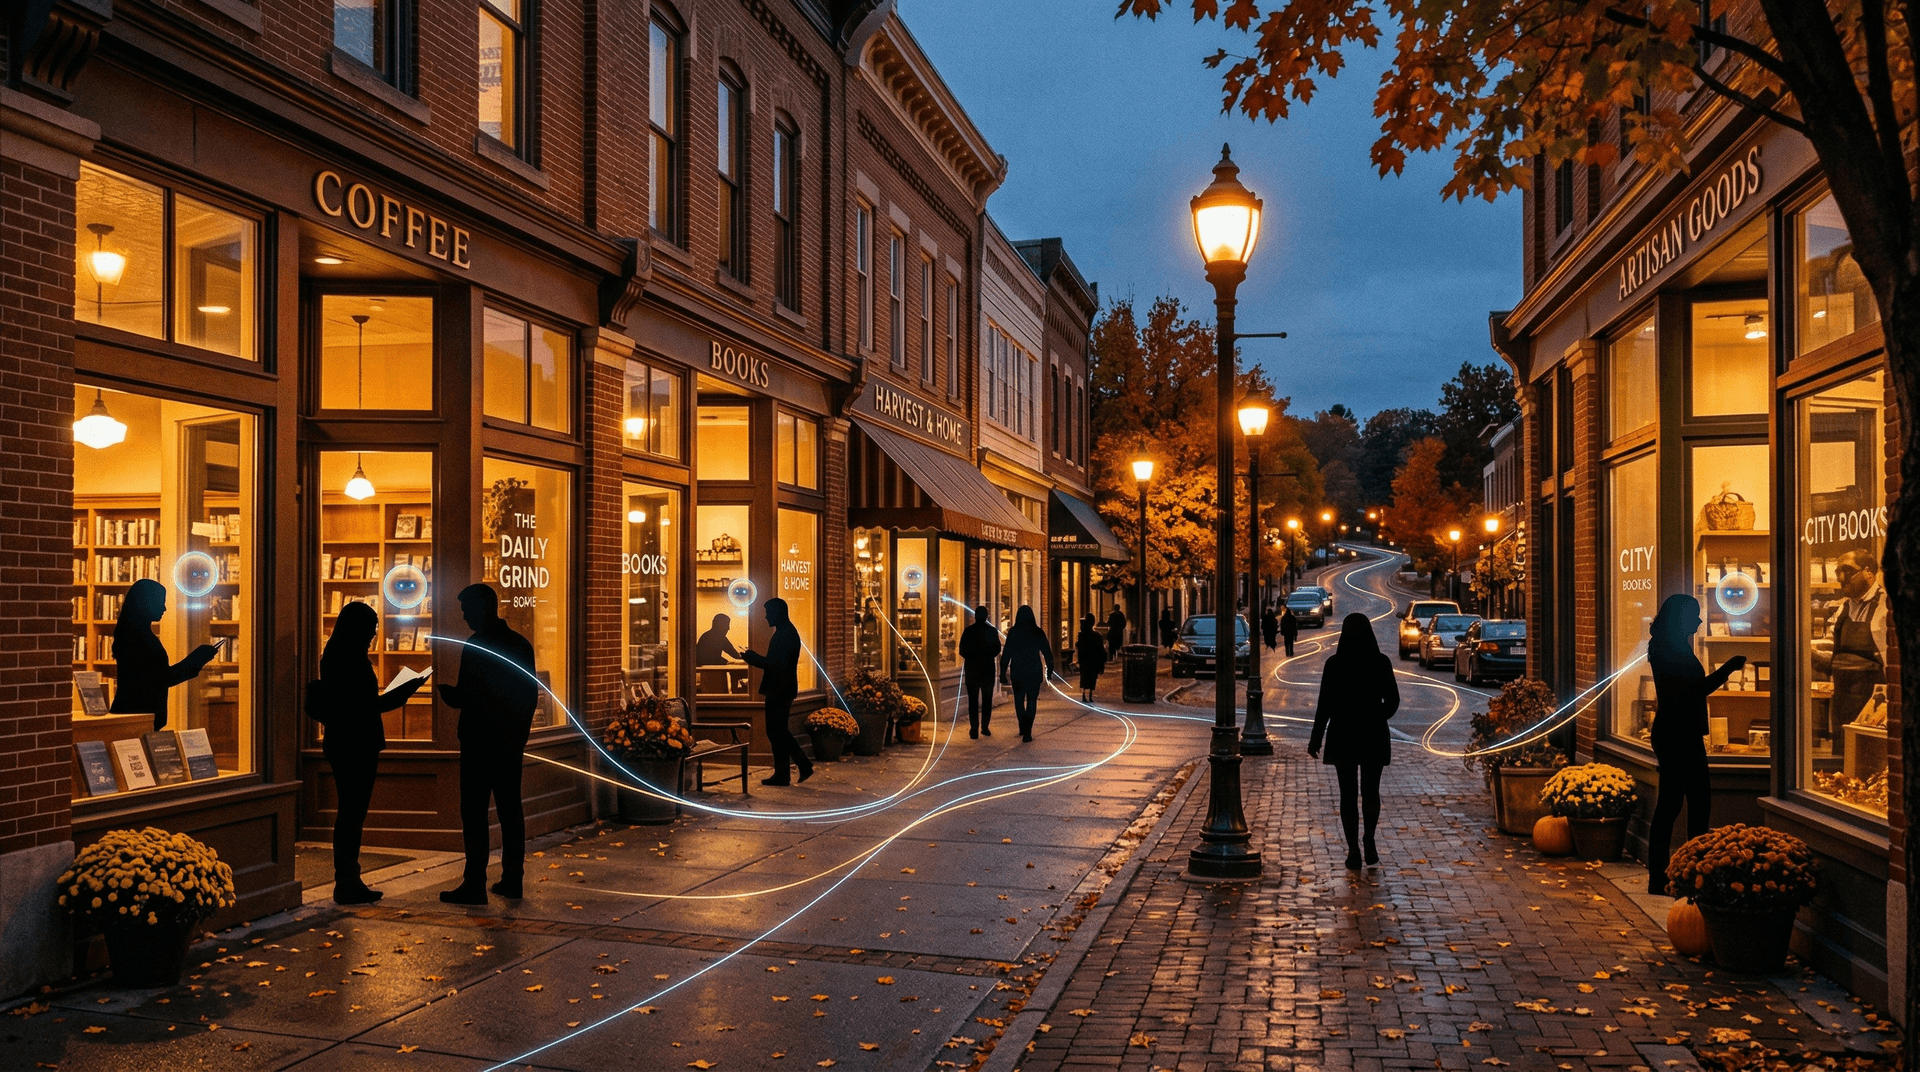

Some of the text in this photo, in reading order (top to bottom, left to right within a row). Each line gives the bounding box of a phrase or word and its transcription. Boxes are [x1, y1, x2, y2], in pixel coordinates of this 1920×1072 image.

[315, 170, 471, 270] COFFEE
[1618, 146, 1760, 301] ARTISAN GOODS
[711, 340, 769, 388] BOOKS
[875, 384, 962, 445] HARVEST & HOME
[514, 512, 537, 529] THE
[1839, 505, 1888, 541] BOOKS
[501, 534, 549, 559] DAILY
[1620, 545, 1654, 573] CITY
[499, 565, 550, 588] GRIND
[621, 552, 667, 575] BOOKS
